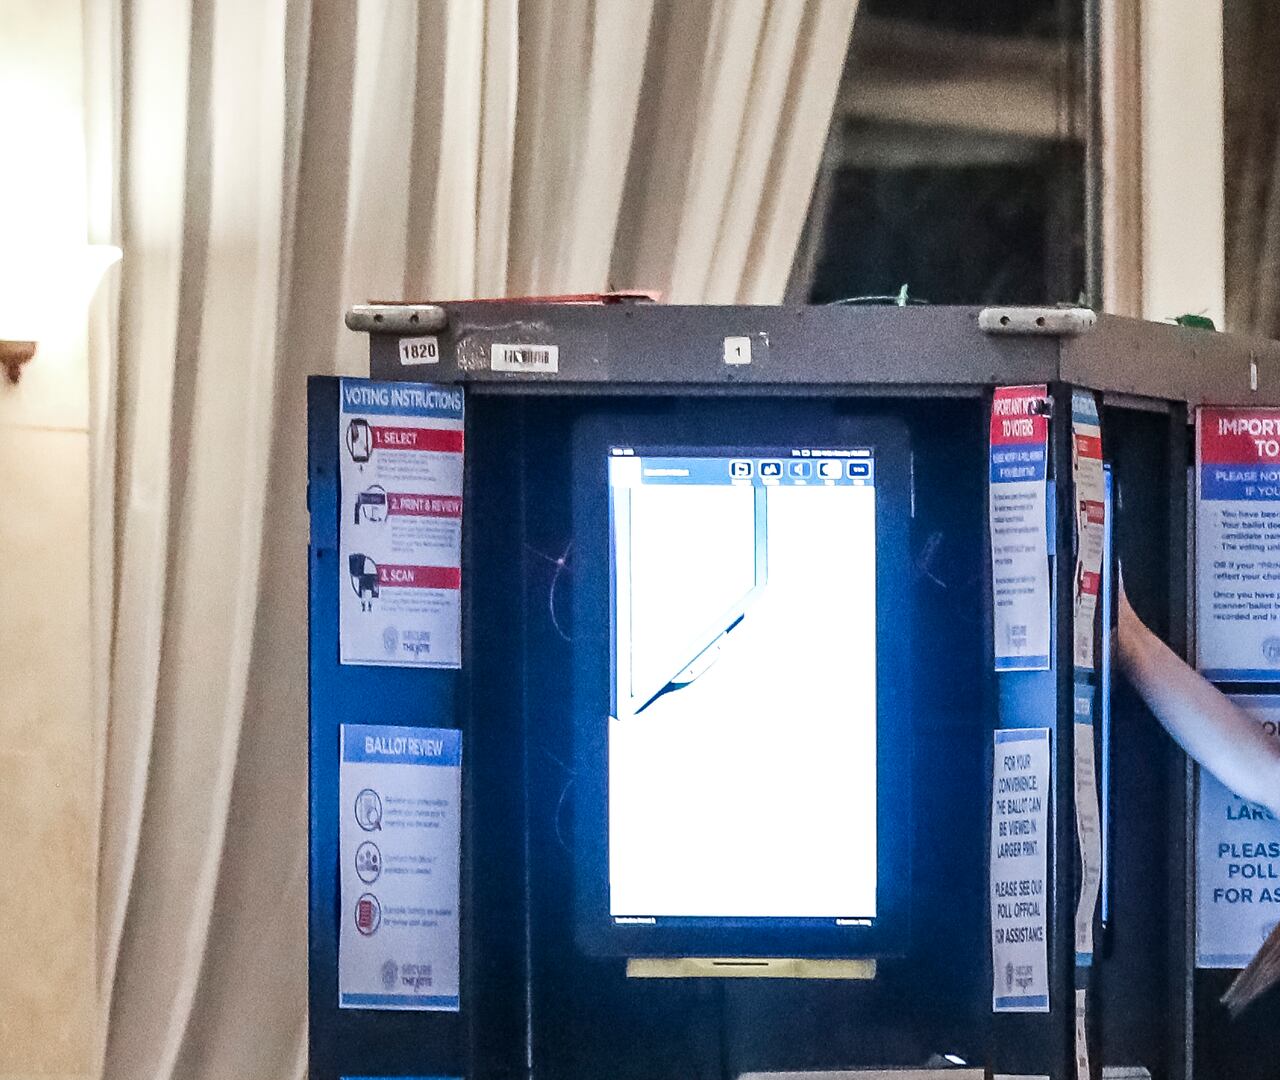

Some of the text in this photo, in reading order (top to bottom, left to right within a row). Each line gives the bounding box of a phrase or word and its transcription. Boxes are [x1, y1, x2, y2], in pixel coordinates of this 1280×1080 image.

[403, 344, 435, 359] 1820
[345, 389, 460, 410] VOTING INSTRUCTIONS
[1002, 419, 1033, 436] TO VOTERS
[384, 433, 417, 444] SELECT
[1255, 441, 1278, 457] TO
[1216, 472, 1257, 482] PLEASE
[1245, 487, 1254, 496] IF
[401, 499, 423, 511] PRINT
[1221, 532, 1262, 540] candidate
[1239, 543, 1265, 552] voting
[1236, 562, 1255, 570] your
[391, 569, 415, 581] SCAN
[1242, 573, 1260, 581] your
[1237, 592, 1252, 600] you
[365, 736, 444, 756] BALLOT REVIEW
[997, 842, 1021, 858] LARGER
[1228, 864, 1278, 878] POLL
[1213, 888, 1253, 903] FOR
